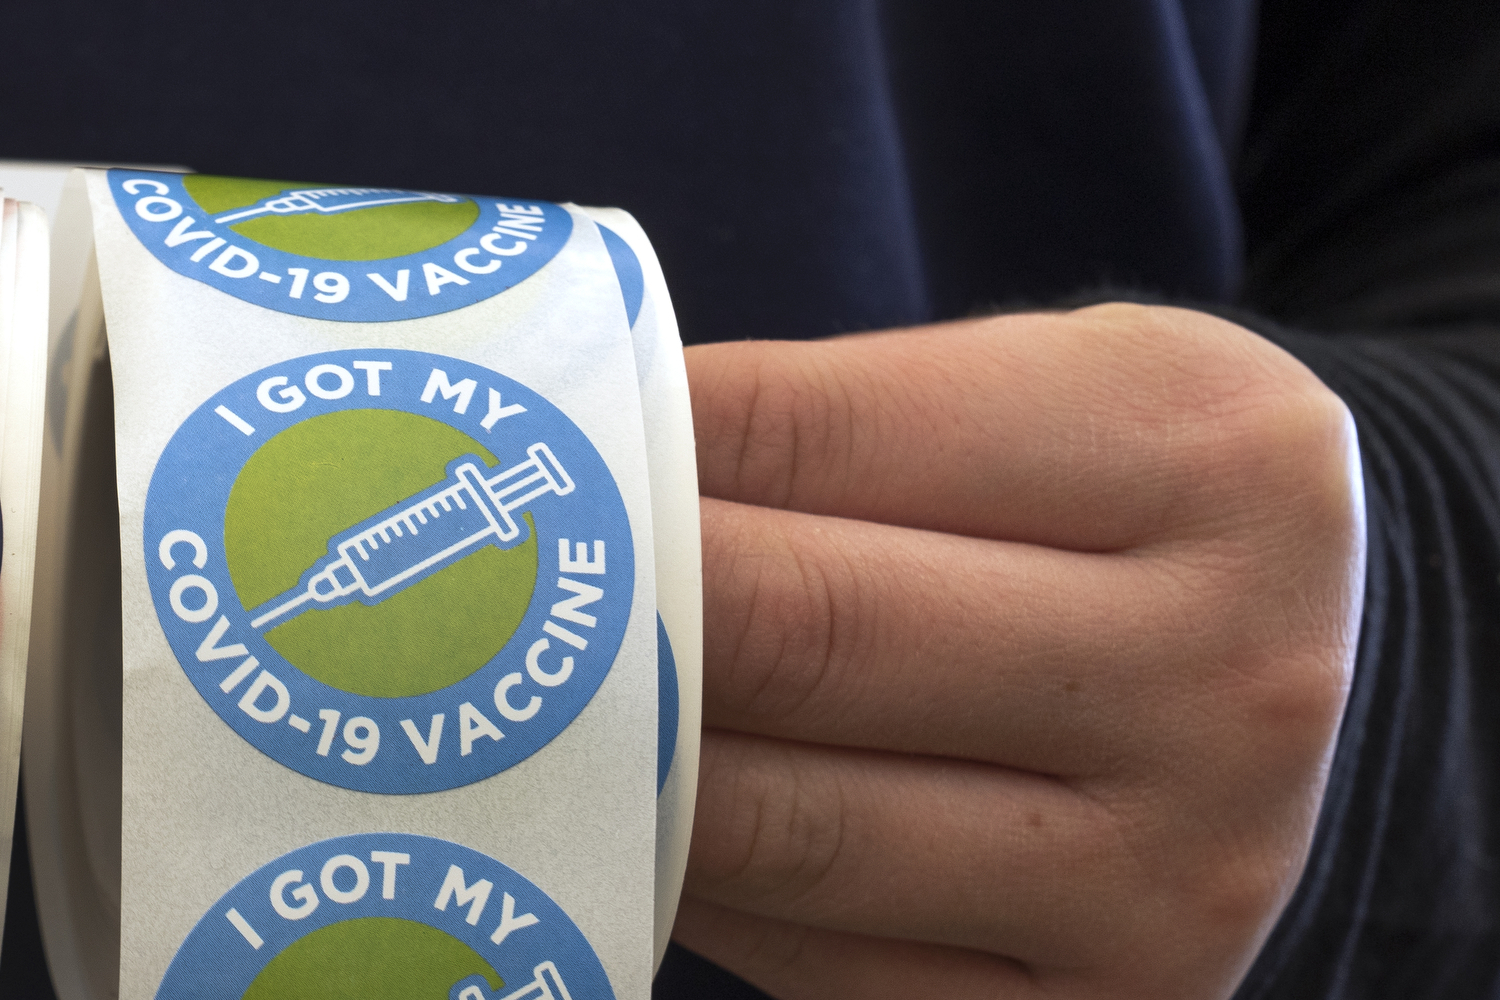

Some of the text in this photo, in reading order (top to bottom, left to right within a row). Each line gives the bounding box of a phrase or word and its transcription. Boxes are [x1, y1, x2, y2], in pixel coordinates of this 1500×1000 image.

[122, 178, 545, 304] COVID-19 VACCINE
[215, 360, 527, 436] I GOT MY
[159, 529, 606, 765] COVID-19 VACCINE
[225, 851, 540, 949] I GOT MY
